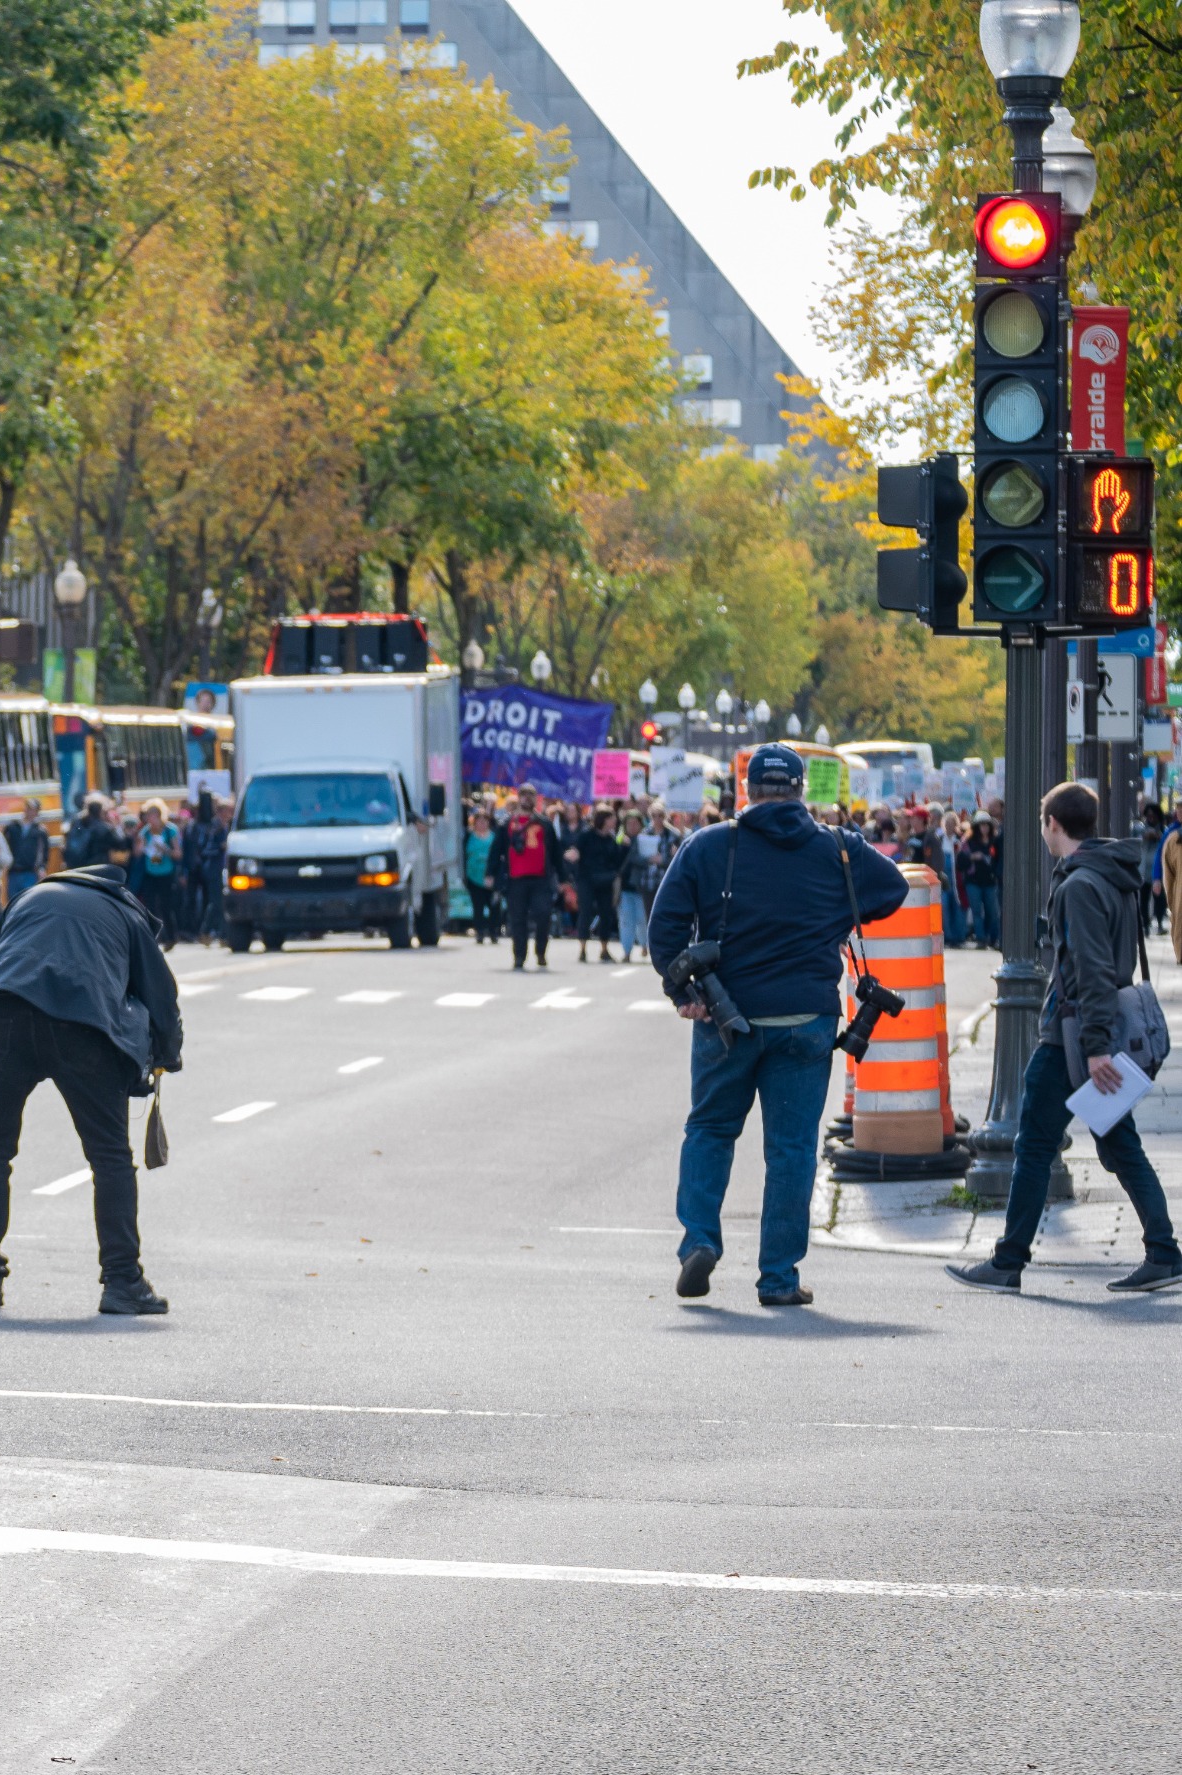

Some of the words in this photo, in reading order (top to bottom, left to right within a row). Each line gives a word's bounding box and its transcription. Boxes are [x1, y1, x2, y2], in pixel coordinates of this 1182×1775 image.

[1110, 553, 1138, 615] 0
[463, 699, 563, 737] DROIT
[470, 726, 593, 770] LOGEMENT
